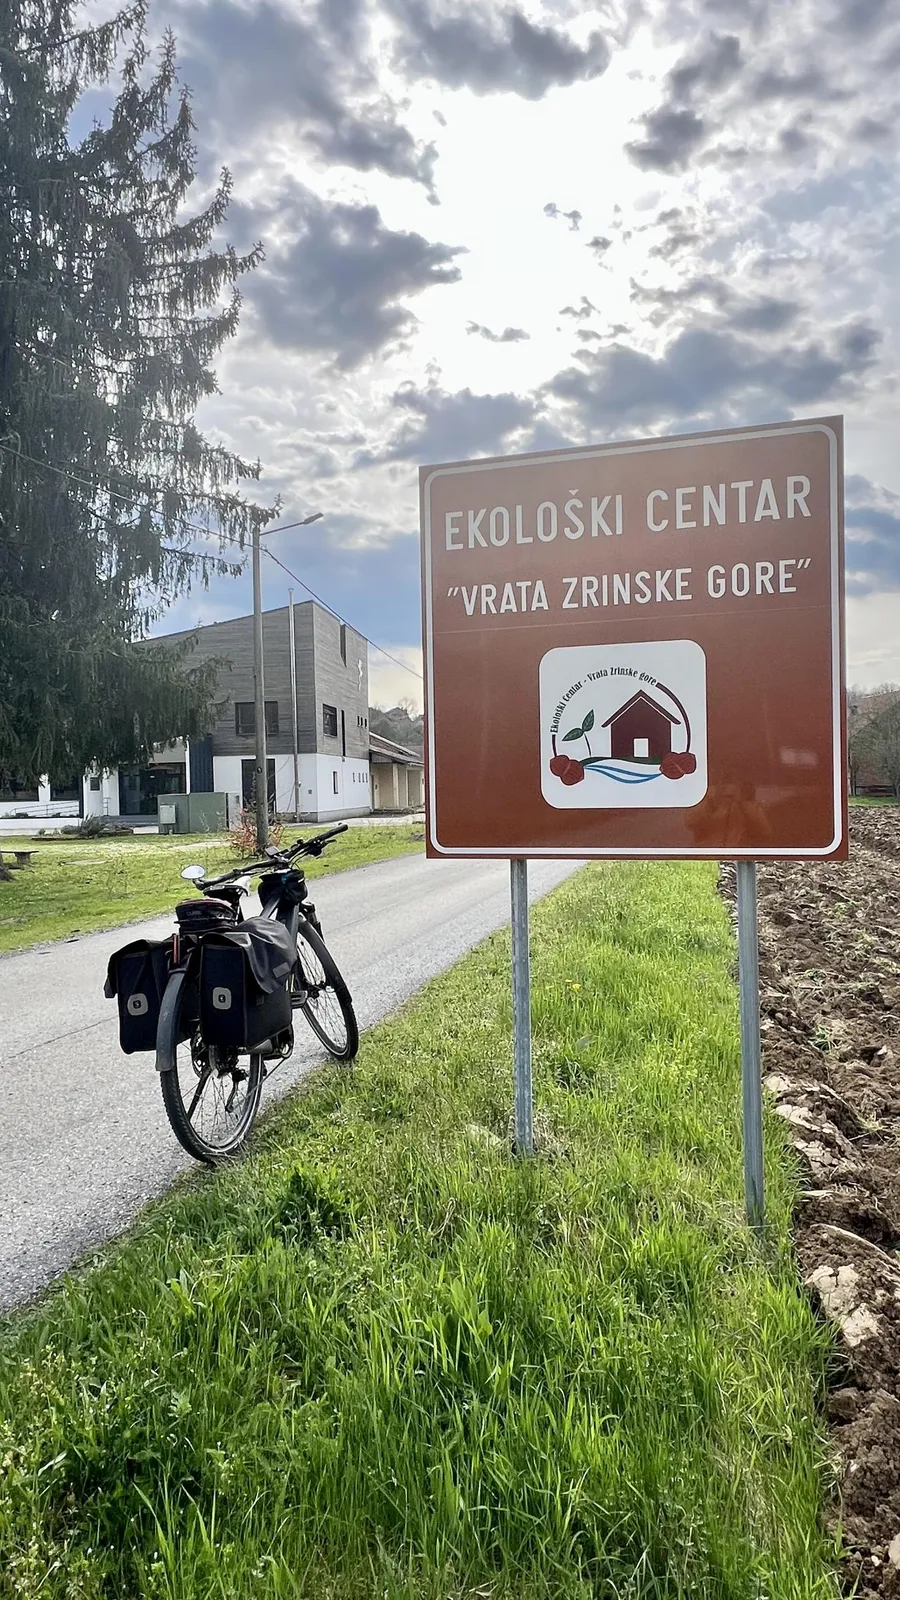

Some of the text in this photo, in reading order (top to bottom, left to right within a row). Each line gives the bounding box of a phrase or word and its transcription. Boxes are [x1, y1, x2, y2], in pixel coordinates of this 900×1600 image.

[445, 475, 812, 551] EKOLOŠKI CENTAR
[447, 557, 812, 616] "VRATA ZRINSKE GORE"
[587, 669, 608, 682] Vrata
[610, 667, 638, 678] Zrinske
[638, 671, 657, 686] gore
